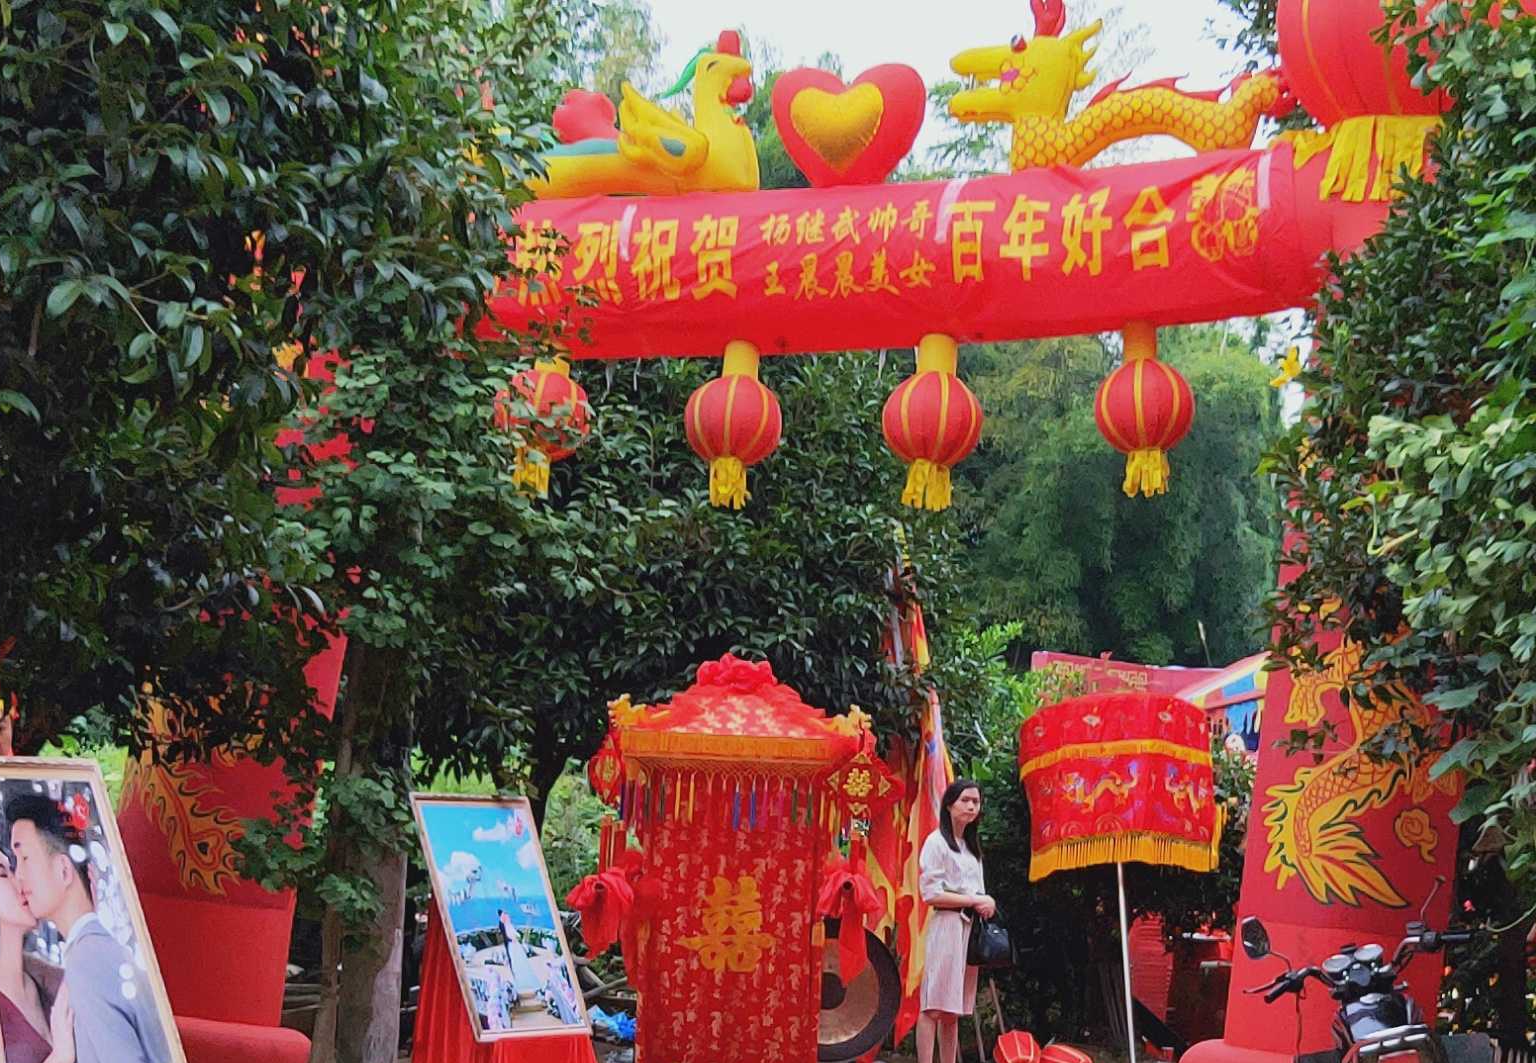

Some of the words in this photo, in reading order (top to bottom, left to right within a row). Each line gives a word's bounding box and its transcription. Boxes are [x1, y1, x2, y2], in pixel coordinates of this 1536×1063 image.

[513, 213, 741, 306] 热烈祝贺
[760, 200, 934, 246] 杨继武帅哥
[950, 184, 1175, 284] 百年好合
[764, 246, 937, 301] 王晨晨美女
